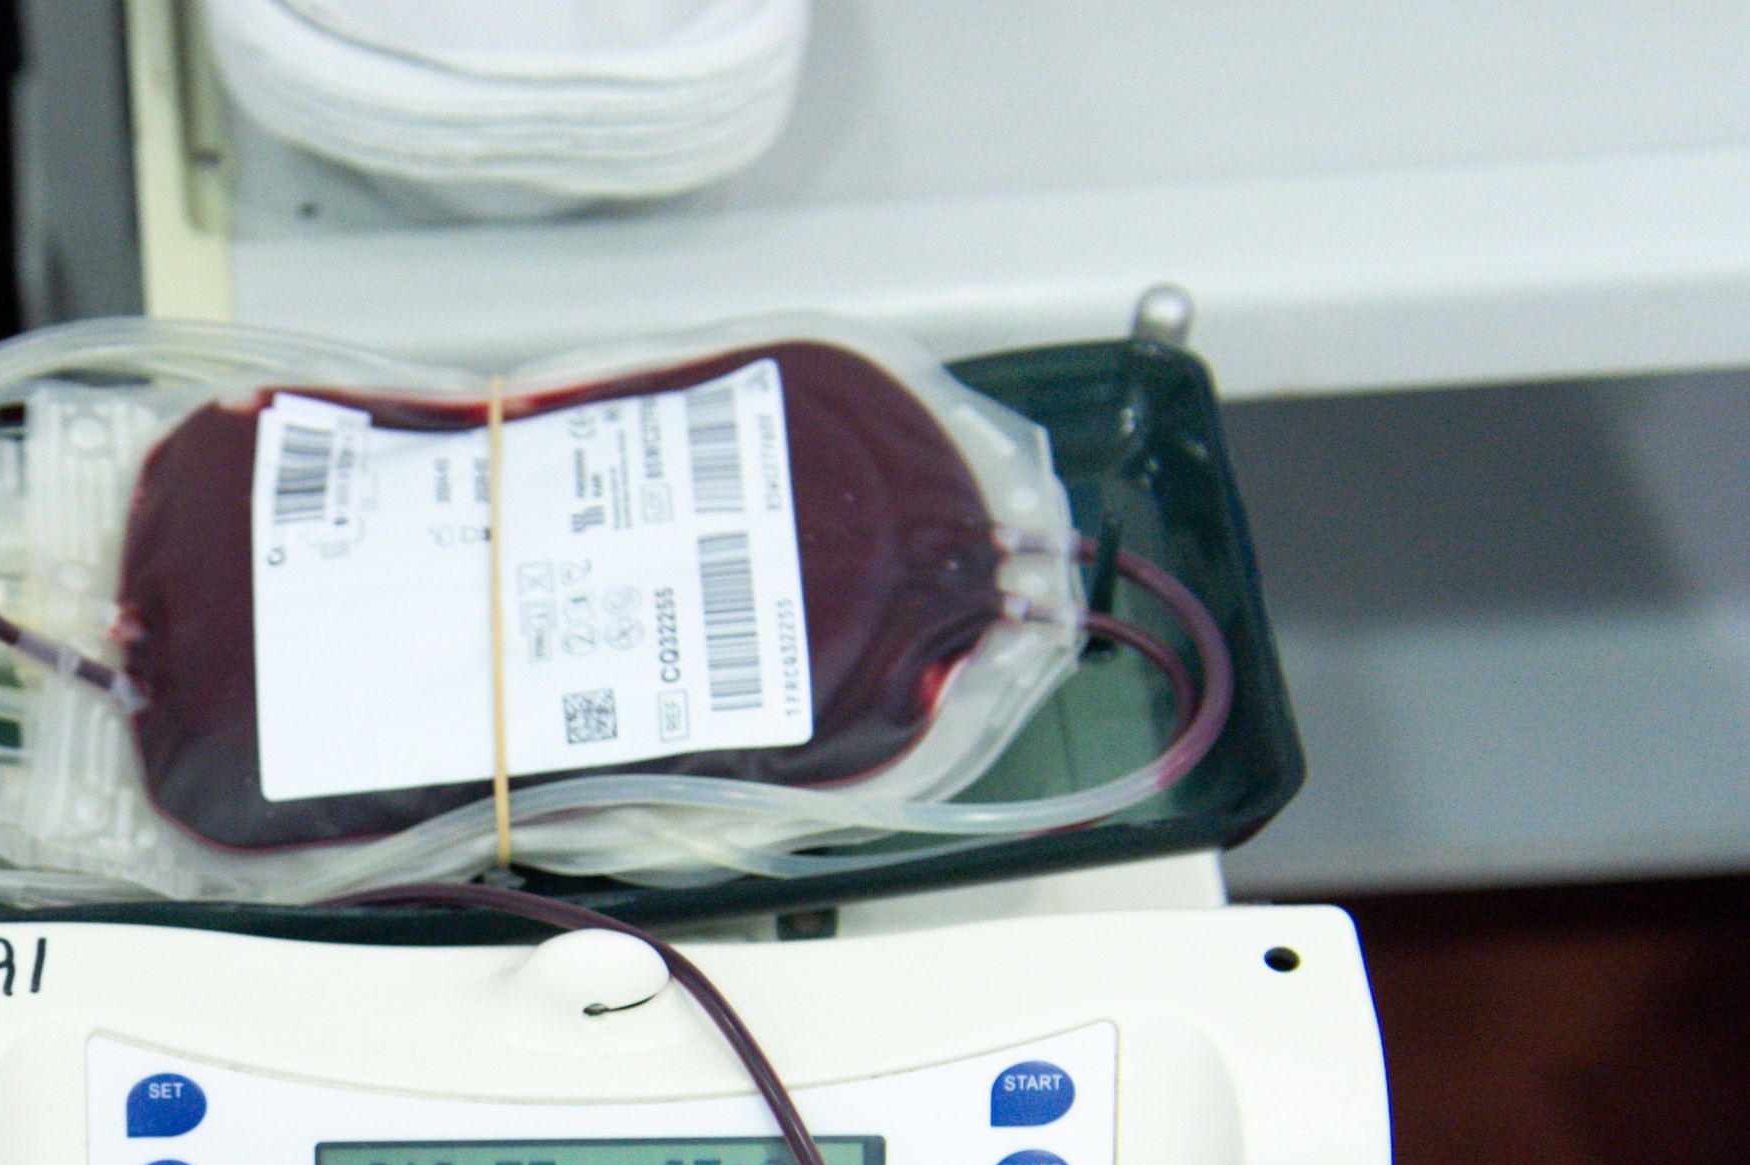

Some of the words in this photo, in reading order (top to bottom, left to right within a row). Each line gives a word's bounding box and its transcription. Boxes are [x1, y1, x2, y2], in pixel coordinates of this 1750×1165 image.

[655, 587, 681, 683] CQ32255
[664, 699, 682, 732] REF
[148, 1082, 184, 1099] SET
[1003, 1074, 1063, 1092] START
